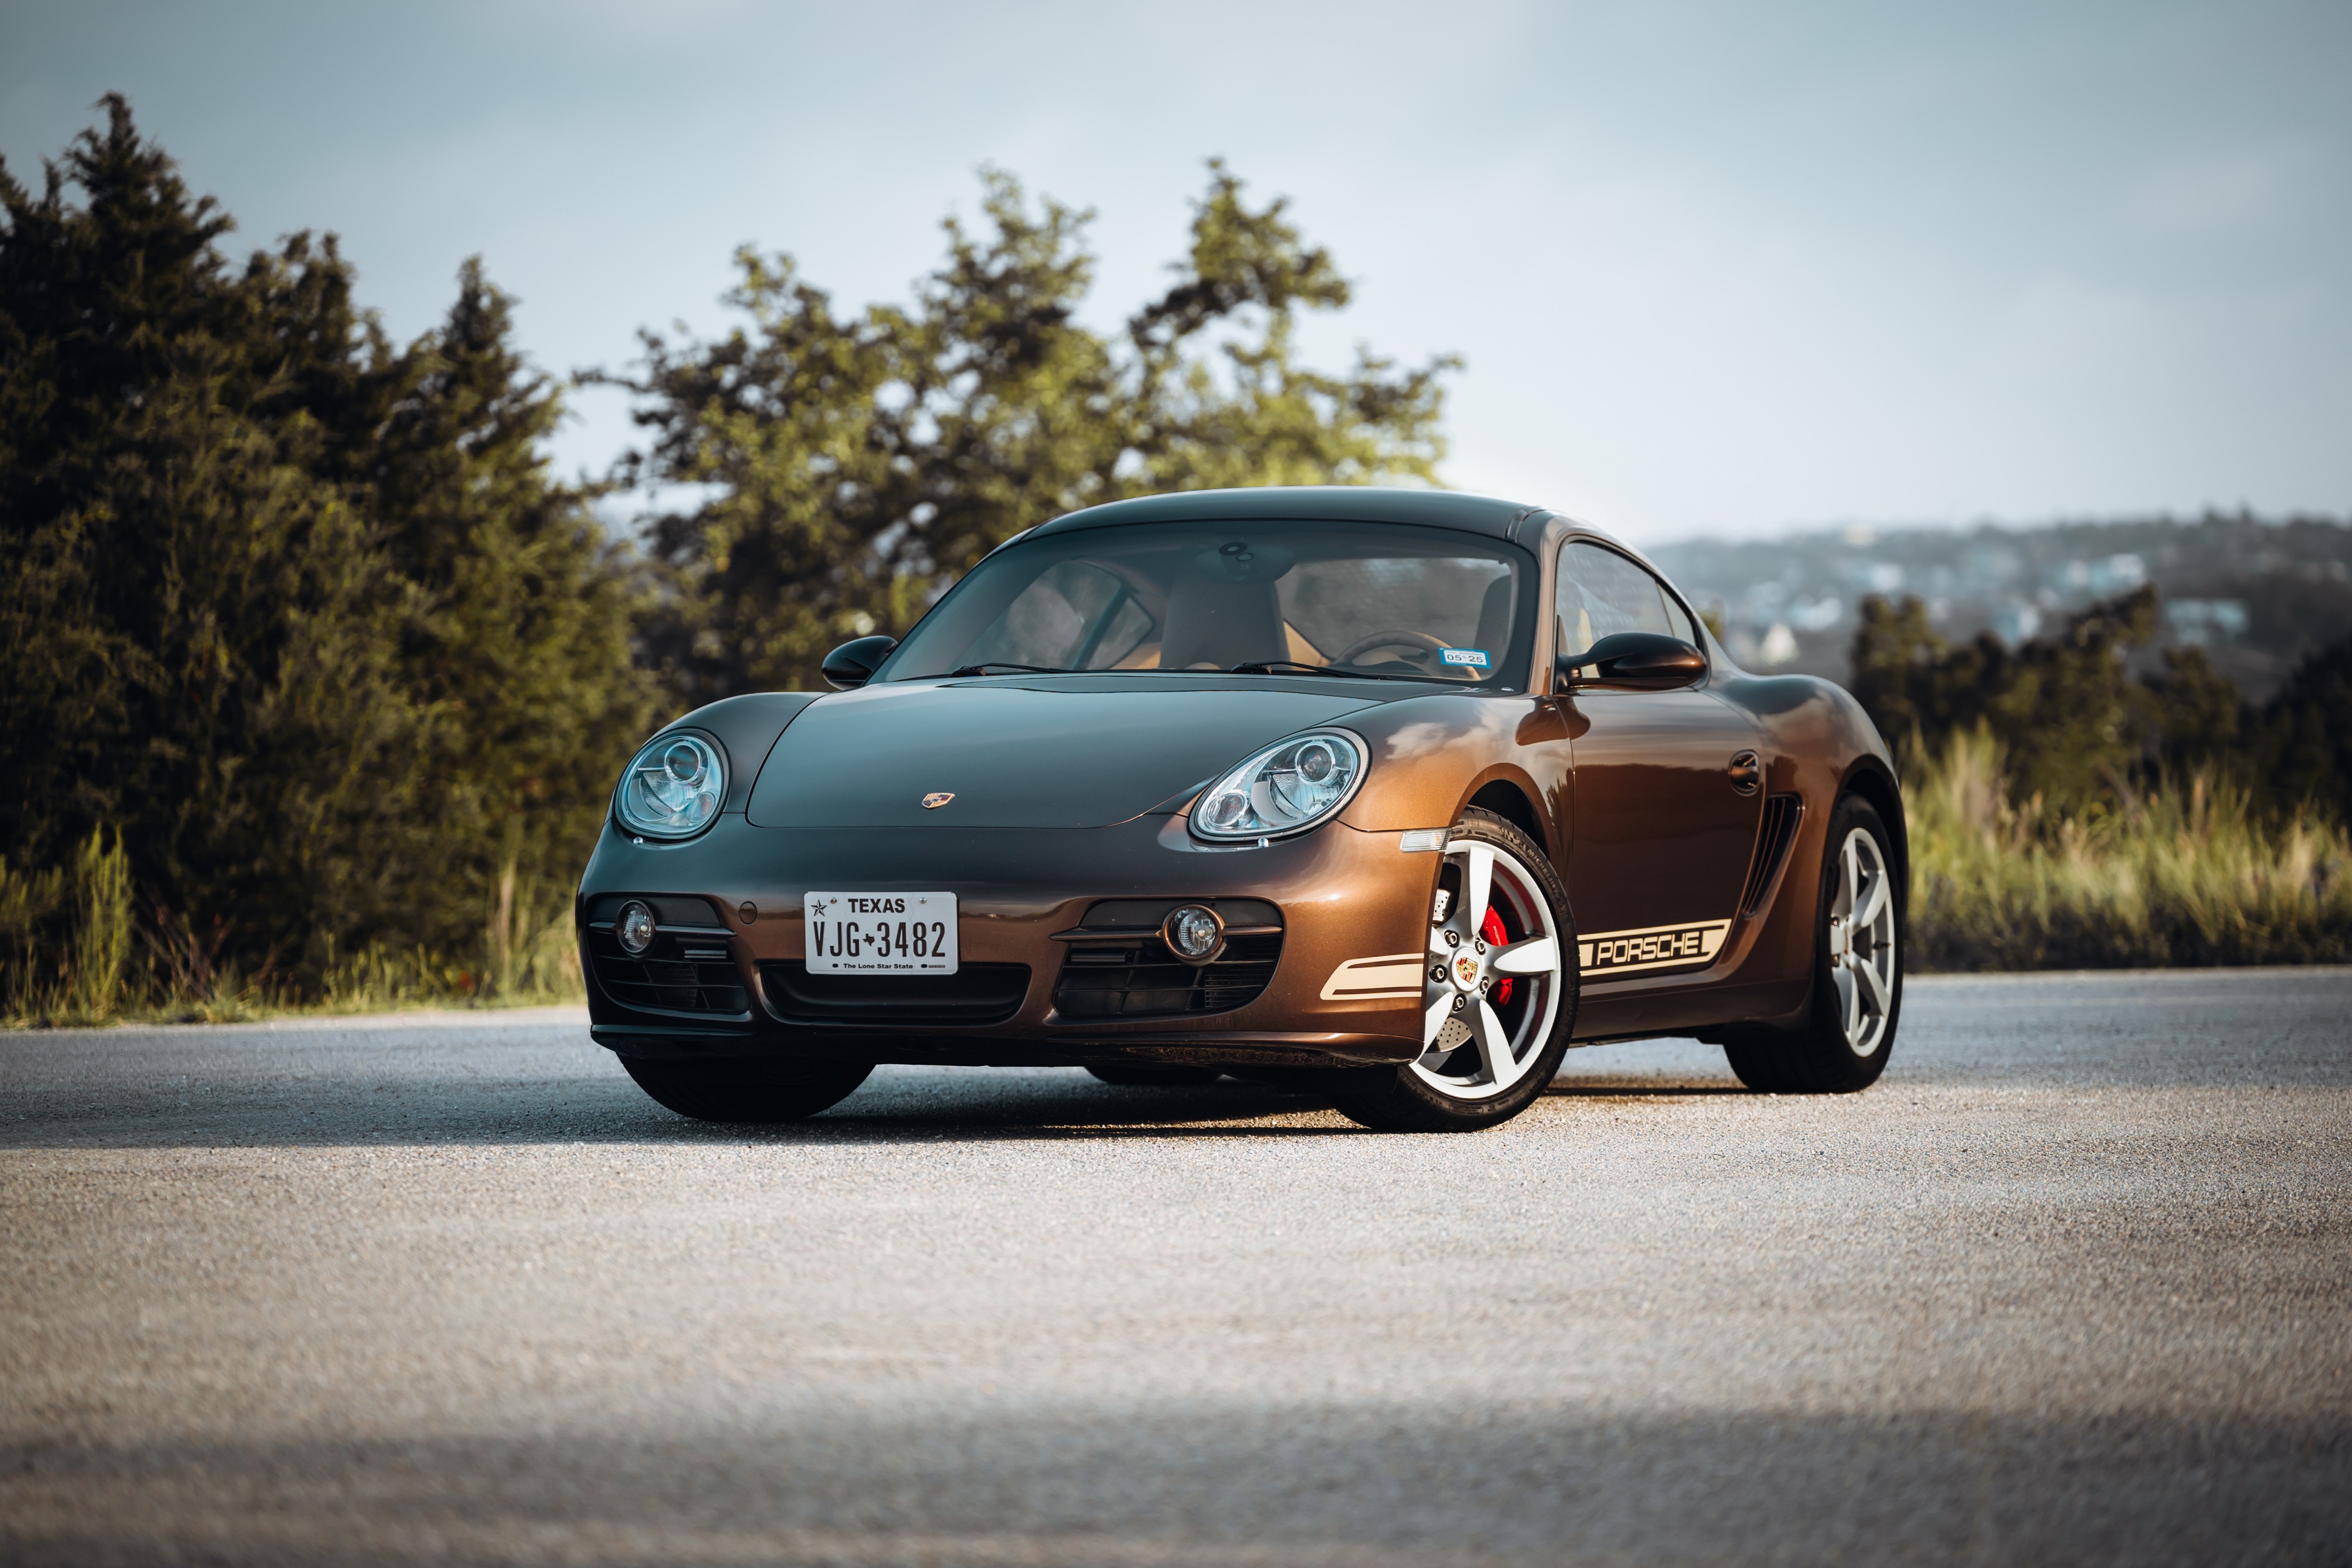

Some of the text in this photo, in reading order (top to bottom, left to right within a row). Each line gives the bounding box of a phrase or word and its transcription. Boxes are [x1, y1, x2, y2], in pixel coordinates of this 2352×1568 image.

[848, 898, 905, 913] TEXAS
[813, 921, 946, 957] VJG 3482
[1596, 931, 1699, 965] PORSCHE
